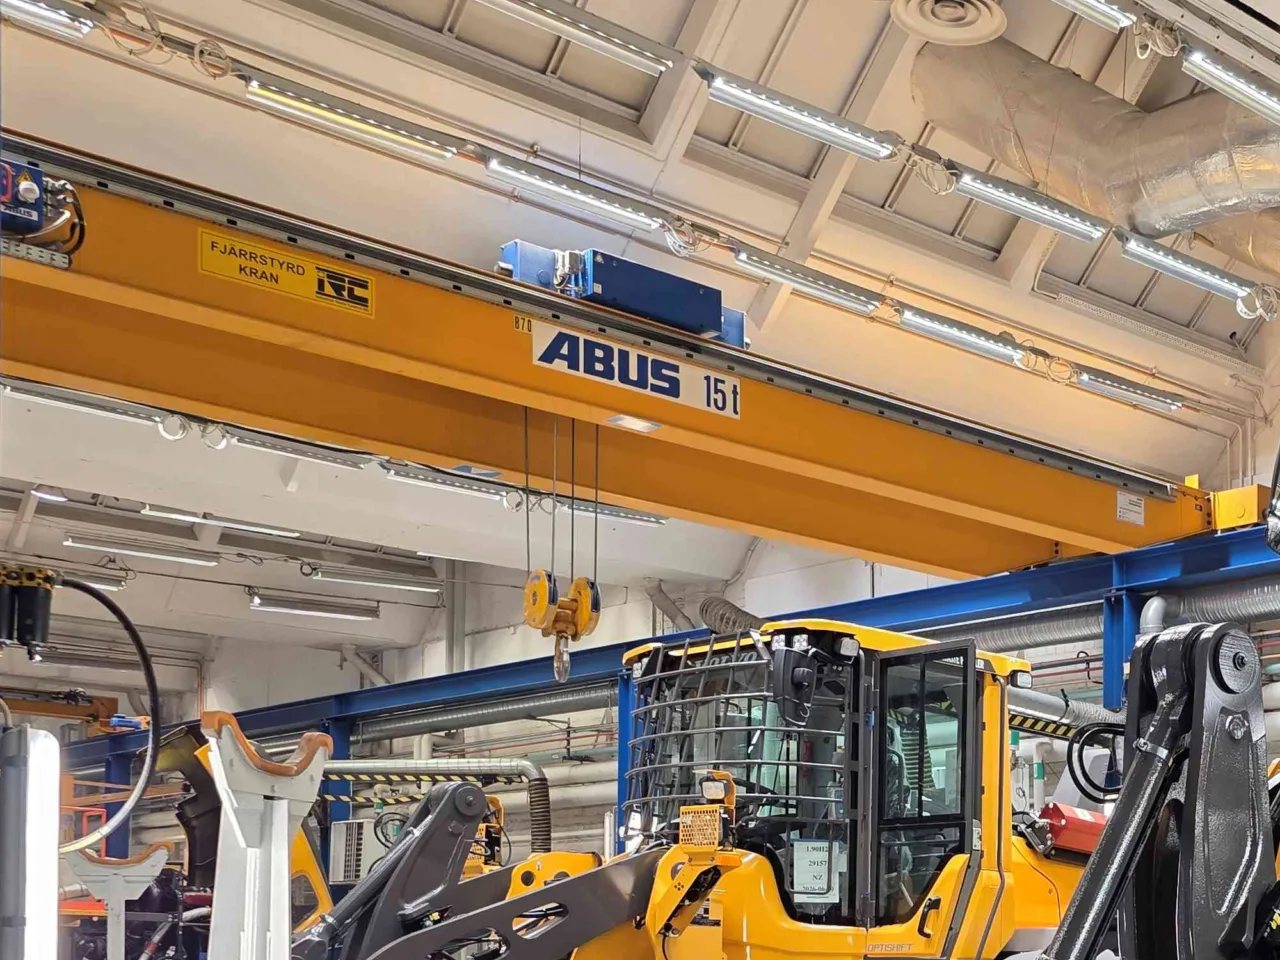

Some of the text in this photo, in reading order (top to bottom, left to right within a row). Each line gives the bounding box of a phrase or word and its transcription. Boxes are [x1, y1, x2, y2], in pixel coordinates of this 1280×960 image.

[210, 241, 306, 277] FJÄRRSTYRD
[238, 263, 280, 285] KRAN
[514, 315, 532, 333] 870
[537, 331, 739, 416] ABUS 15 t
[867, 943, 913, 952] OPTISHIFT
